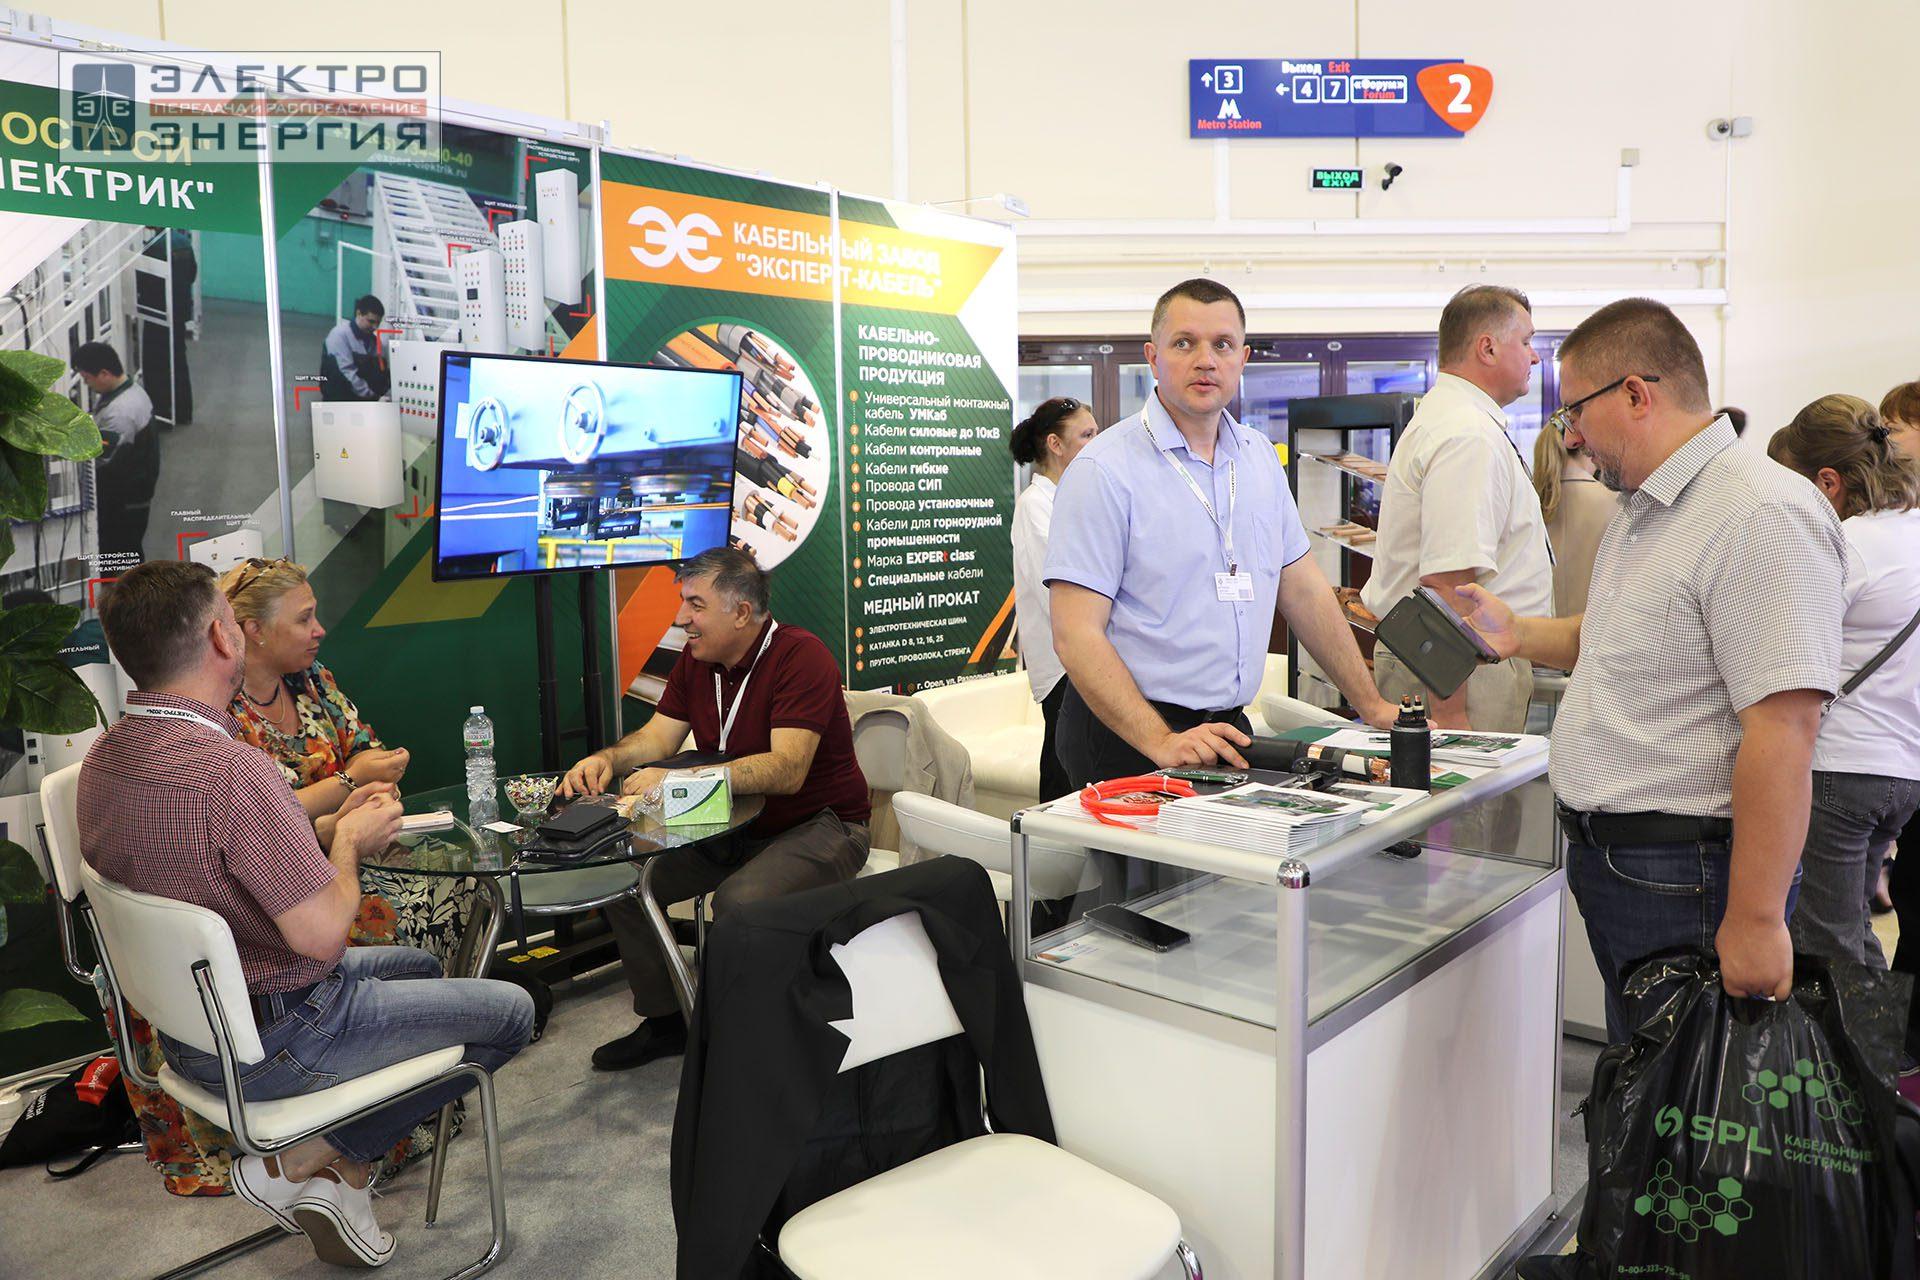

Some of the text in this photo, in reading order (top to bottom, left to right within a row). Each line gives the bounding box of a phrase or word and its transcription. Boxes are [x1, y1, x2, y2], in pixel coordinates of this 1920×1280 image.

[1281, 60, 1350, 75] Выход Exit
[1223, 71, 1234, 88] 3
[1300, 81, 1341, 97] 4 7
[1363, 90, 1396, 99] Forum
[1447, 74, 1472, 113] 2
[1197, 119, 1262, 129] Metro Station
[0, 157, 214, 210] ЕКТРИК"
[1316, 171, 1359, 182] ВЫХОД
[733, 221, 941, 275] КАБЕЛЬНЫЙ ЗАВОД
[858, 324, 939, 345] КАБЕЛЬНО-
[859, 345, 982, 368] ПРОВОДНИКОВАЯ
[859, 366, 945, 386] ПРОДУКЦИЯ
[864, 391, 950, 407] Универсальный
[953, 398, 1010, 410] монтажный
[865, 407, 947, 421] кабель УМКаб
[864, 424, 906, 437] Кабели
[909, 427, 957, 438] силовые
[959, 428, 973, 440] до
[975, 426, 1000, 439] 10кВ
[865, 443, 907, 456] Кабели
[909, 445, 982, 458] контрольные
[865, 462, 907, 475] Кабели
[910, 462, 949, 475] гибкие
[866, 480, 915, 493] Провода
[918, 478, 942, 491] СИП
[866, 499, 915, 513] Провода
[918, 498, 995, 512] установочные
[866, 518, 908, 531] Кабели
[910, 517, 931, 530] для
[933, 514, 1003, 529] горнорудной
[867, 533, 960, 549] промышенности
[95, 551, 140, 560] УСТРОЙСТВА
[867, 554, 902, 569] Марка
[868, 570, 945, 587] Специальные
[947, 567, 983, 580] кабели
[864, 590, 981, 615] МЕДНЫЙ ПРОКАТ
[869, 618, 947, 634] ЭЛЕКТРОТЕХНИЧЕСКАЯ
[947, 616, 967, 626] ШИНА
[869, 640, 901, 651] КАТАНКА
[902, 638, 907, 646] D
[916, 637, 925, 645] 12,
[869, 657, 897, 668] ПРУТОК,
[898, 651, 943, 663] ПРОВОЛОКА,
[943, 647, 971, 657] СТРЕНГА
[1690, 1114, 1772, 1156] SPL
[1784, 1133, 1872, 1162] КАБЕЛЬНЫЕ
[1783, 1149, 1858, 1175] СИСТЕМЫ
